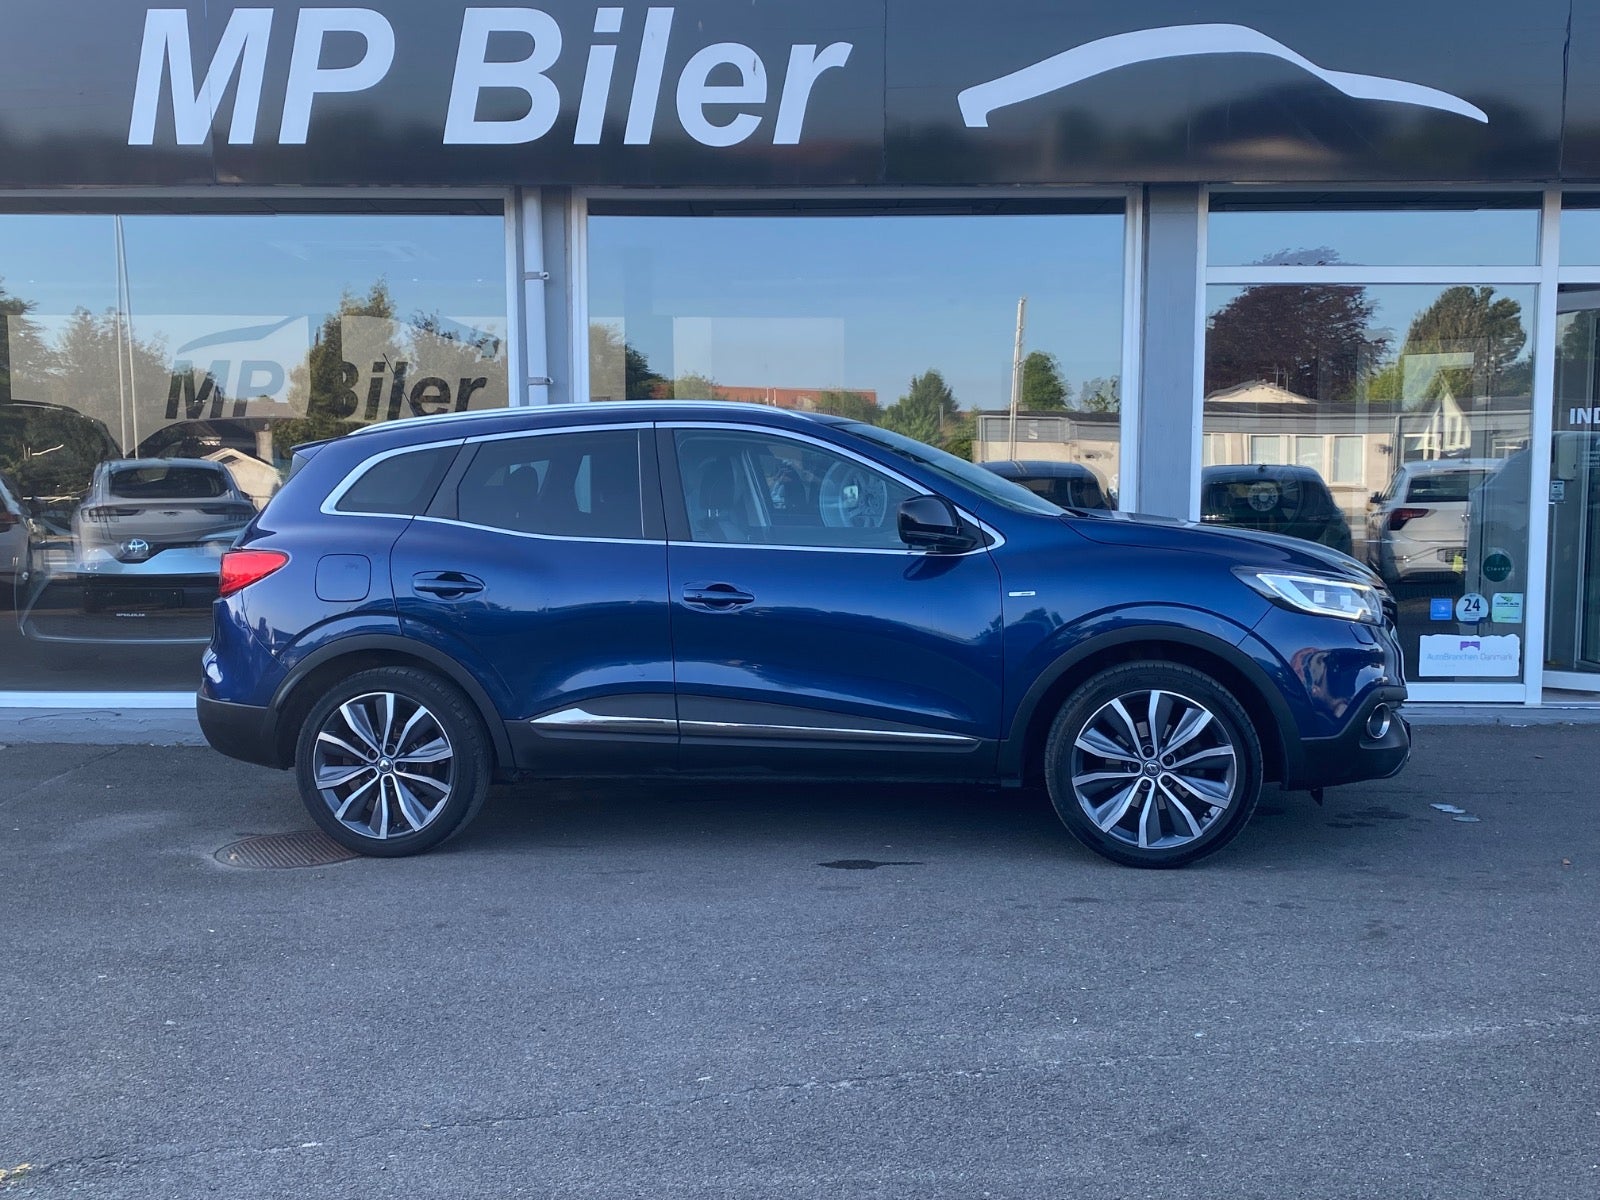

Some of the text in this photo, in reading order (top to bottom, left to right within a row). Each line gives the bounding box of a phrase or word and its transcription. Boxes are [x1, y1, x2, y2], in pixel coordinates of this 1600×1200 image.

[128, 7, 853, 147] MP Biler
[165, 360, 487, 420] MP Biler
[1464, 598, 1480, 611] 24
